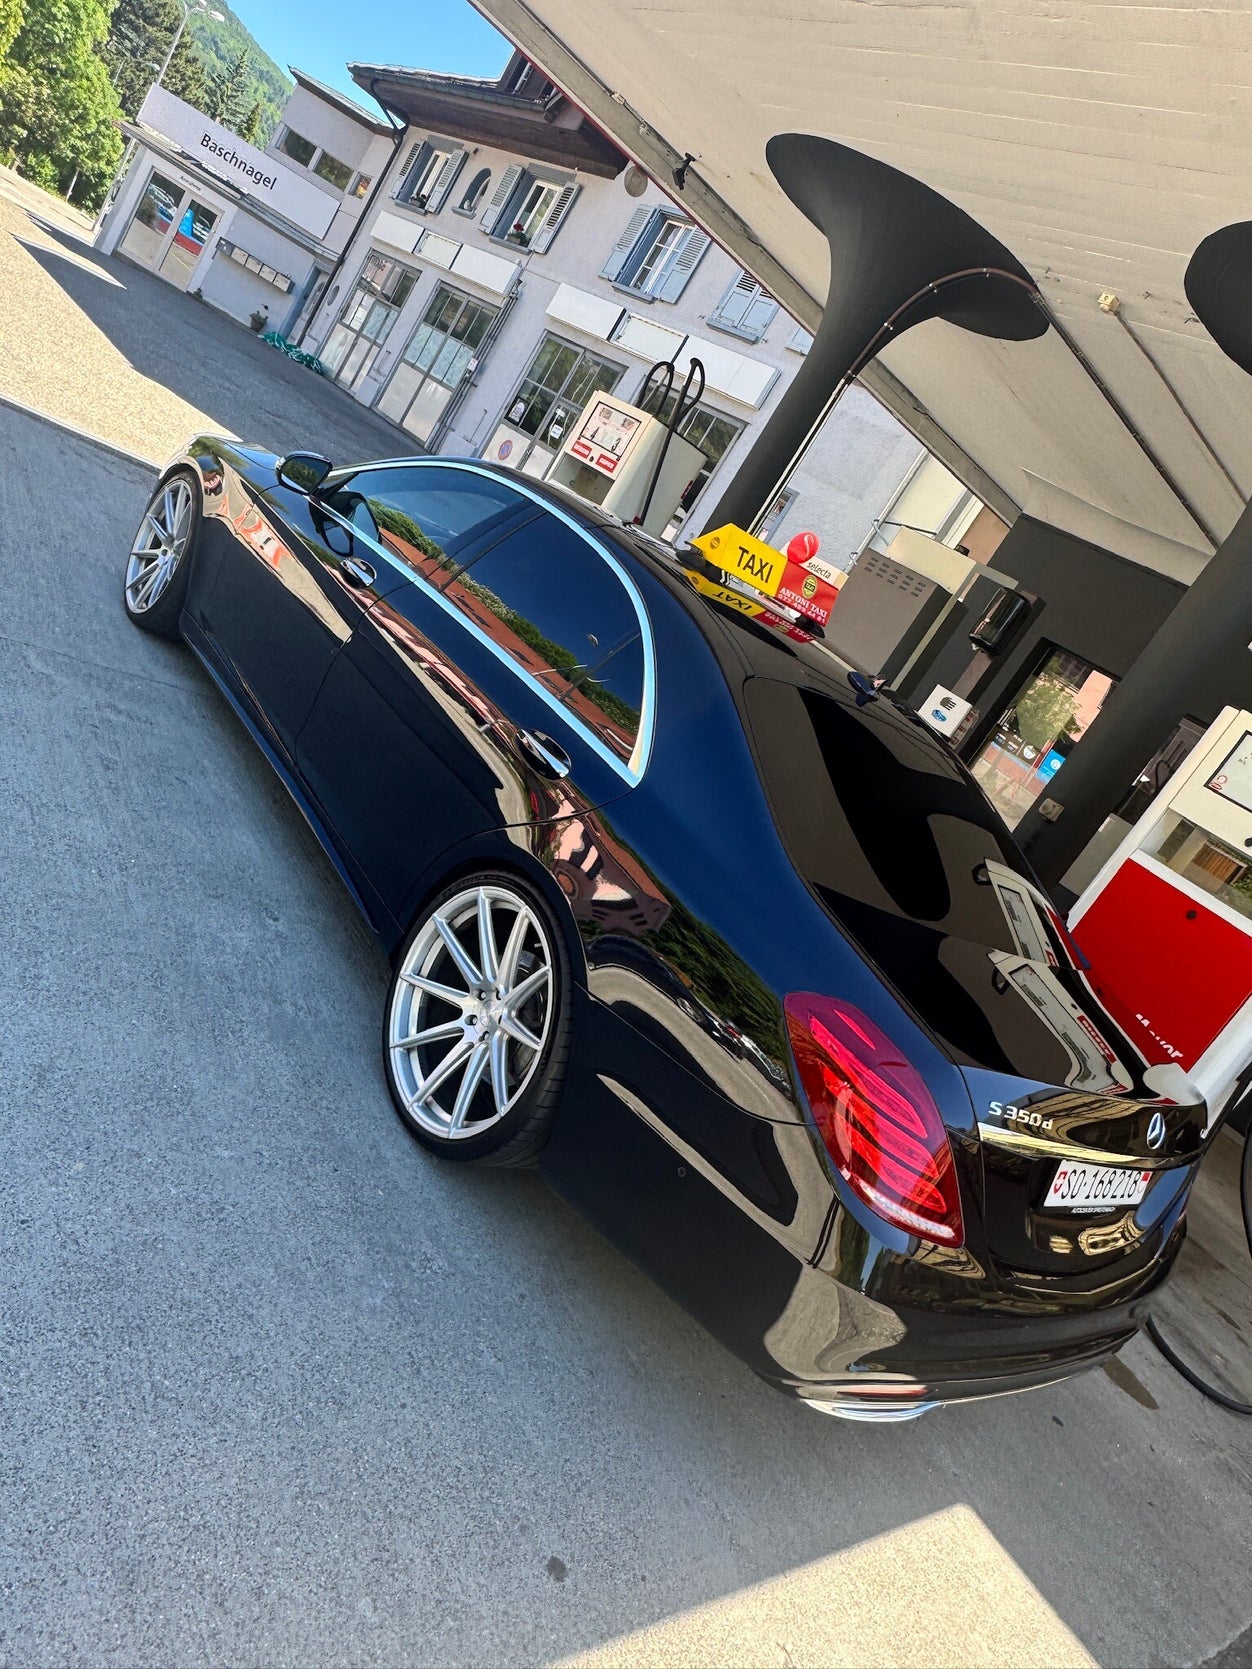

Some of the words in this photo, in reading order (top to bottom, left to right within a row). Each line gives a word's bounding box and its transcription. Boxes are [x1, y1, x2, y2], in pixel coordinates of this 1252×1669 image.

[200, 133, 278, 190] Baschnagel
[737, 546, 774, 583] TAXI
[806, 561, 832, 579] selecta
[780, 587, 809, 610] ANTONI
[809, 604, 828, 617] TAXI
